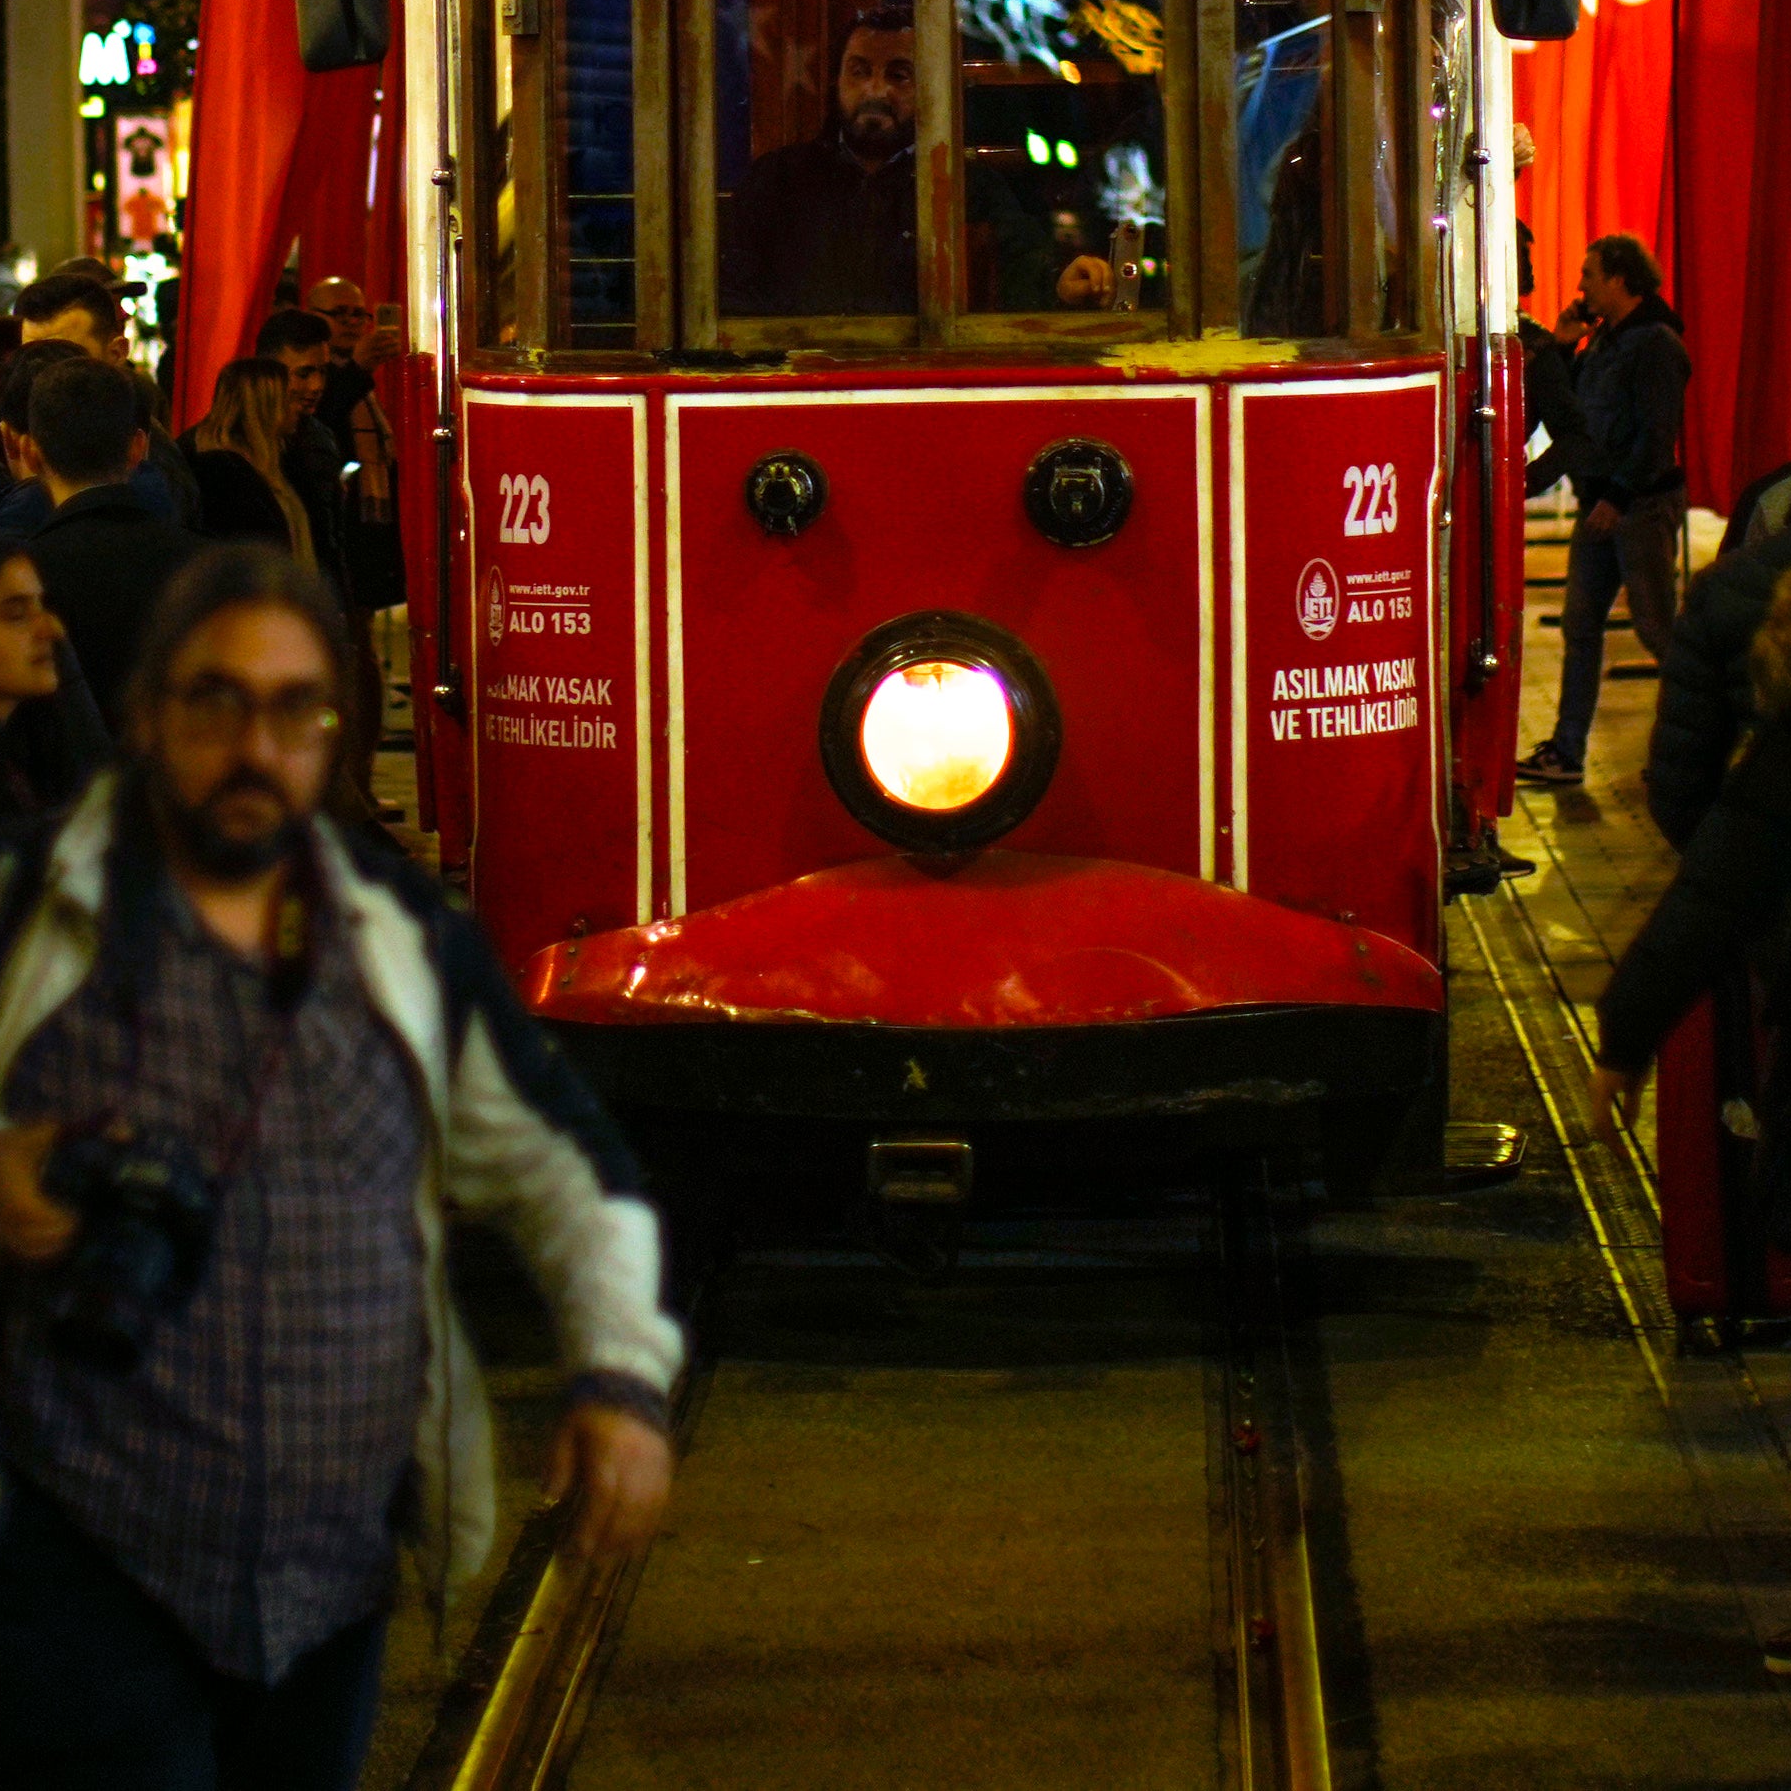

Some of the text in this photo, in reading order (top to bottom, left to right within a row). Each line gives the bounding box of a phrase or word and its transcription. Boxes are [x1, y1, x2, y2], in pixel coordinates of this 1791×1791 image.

[499, 473, 551, 545] 223
[1343, 462, 1398, 537] 223
[508, 583, 591, 598] www.iett.gov.tr
[508, 611, 545, 634] ALO
[550, 612, 592, 635] 153
[1346, 595, 1413, 624] ALO 153
[544, 676, 612, 706] YASAK
[1272, 658, 1417, 702] ASILMAK YASAK
[496, 712, 617, 749] TEHLİKELİDİR
[1269, 691, 1418, 741] VE TEHLİKELİDİR
